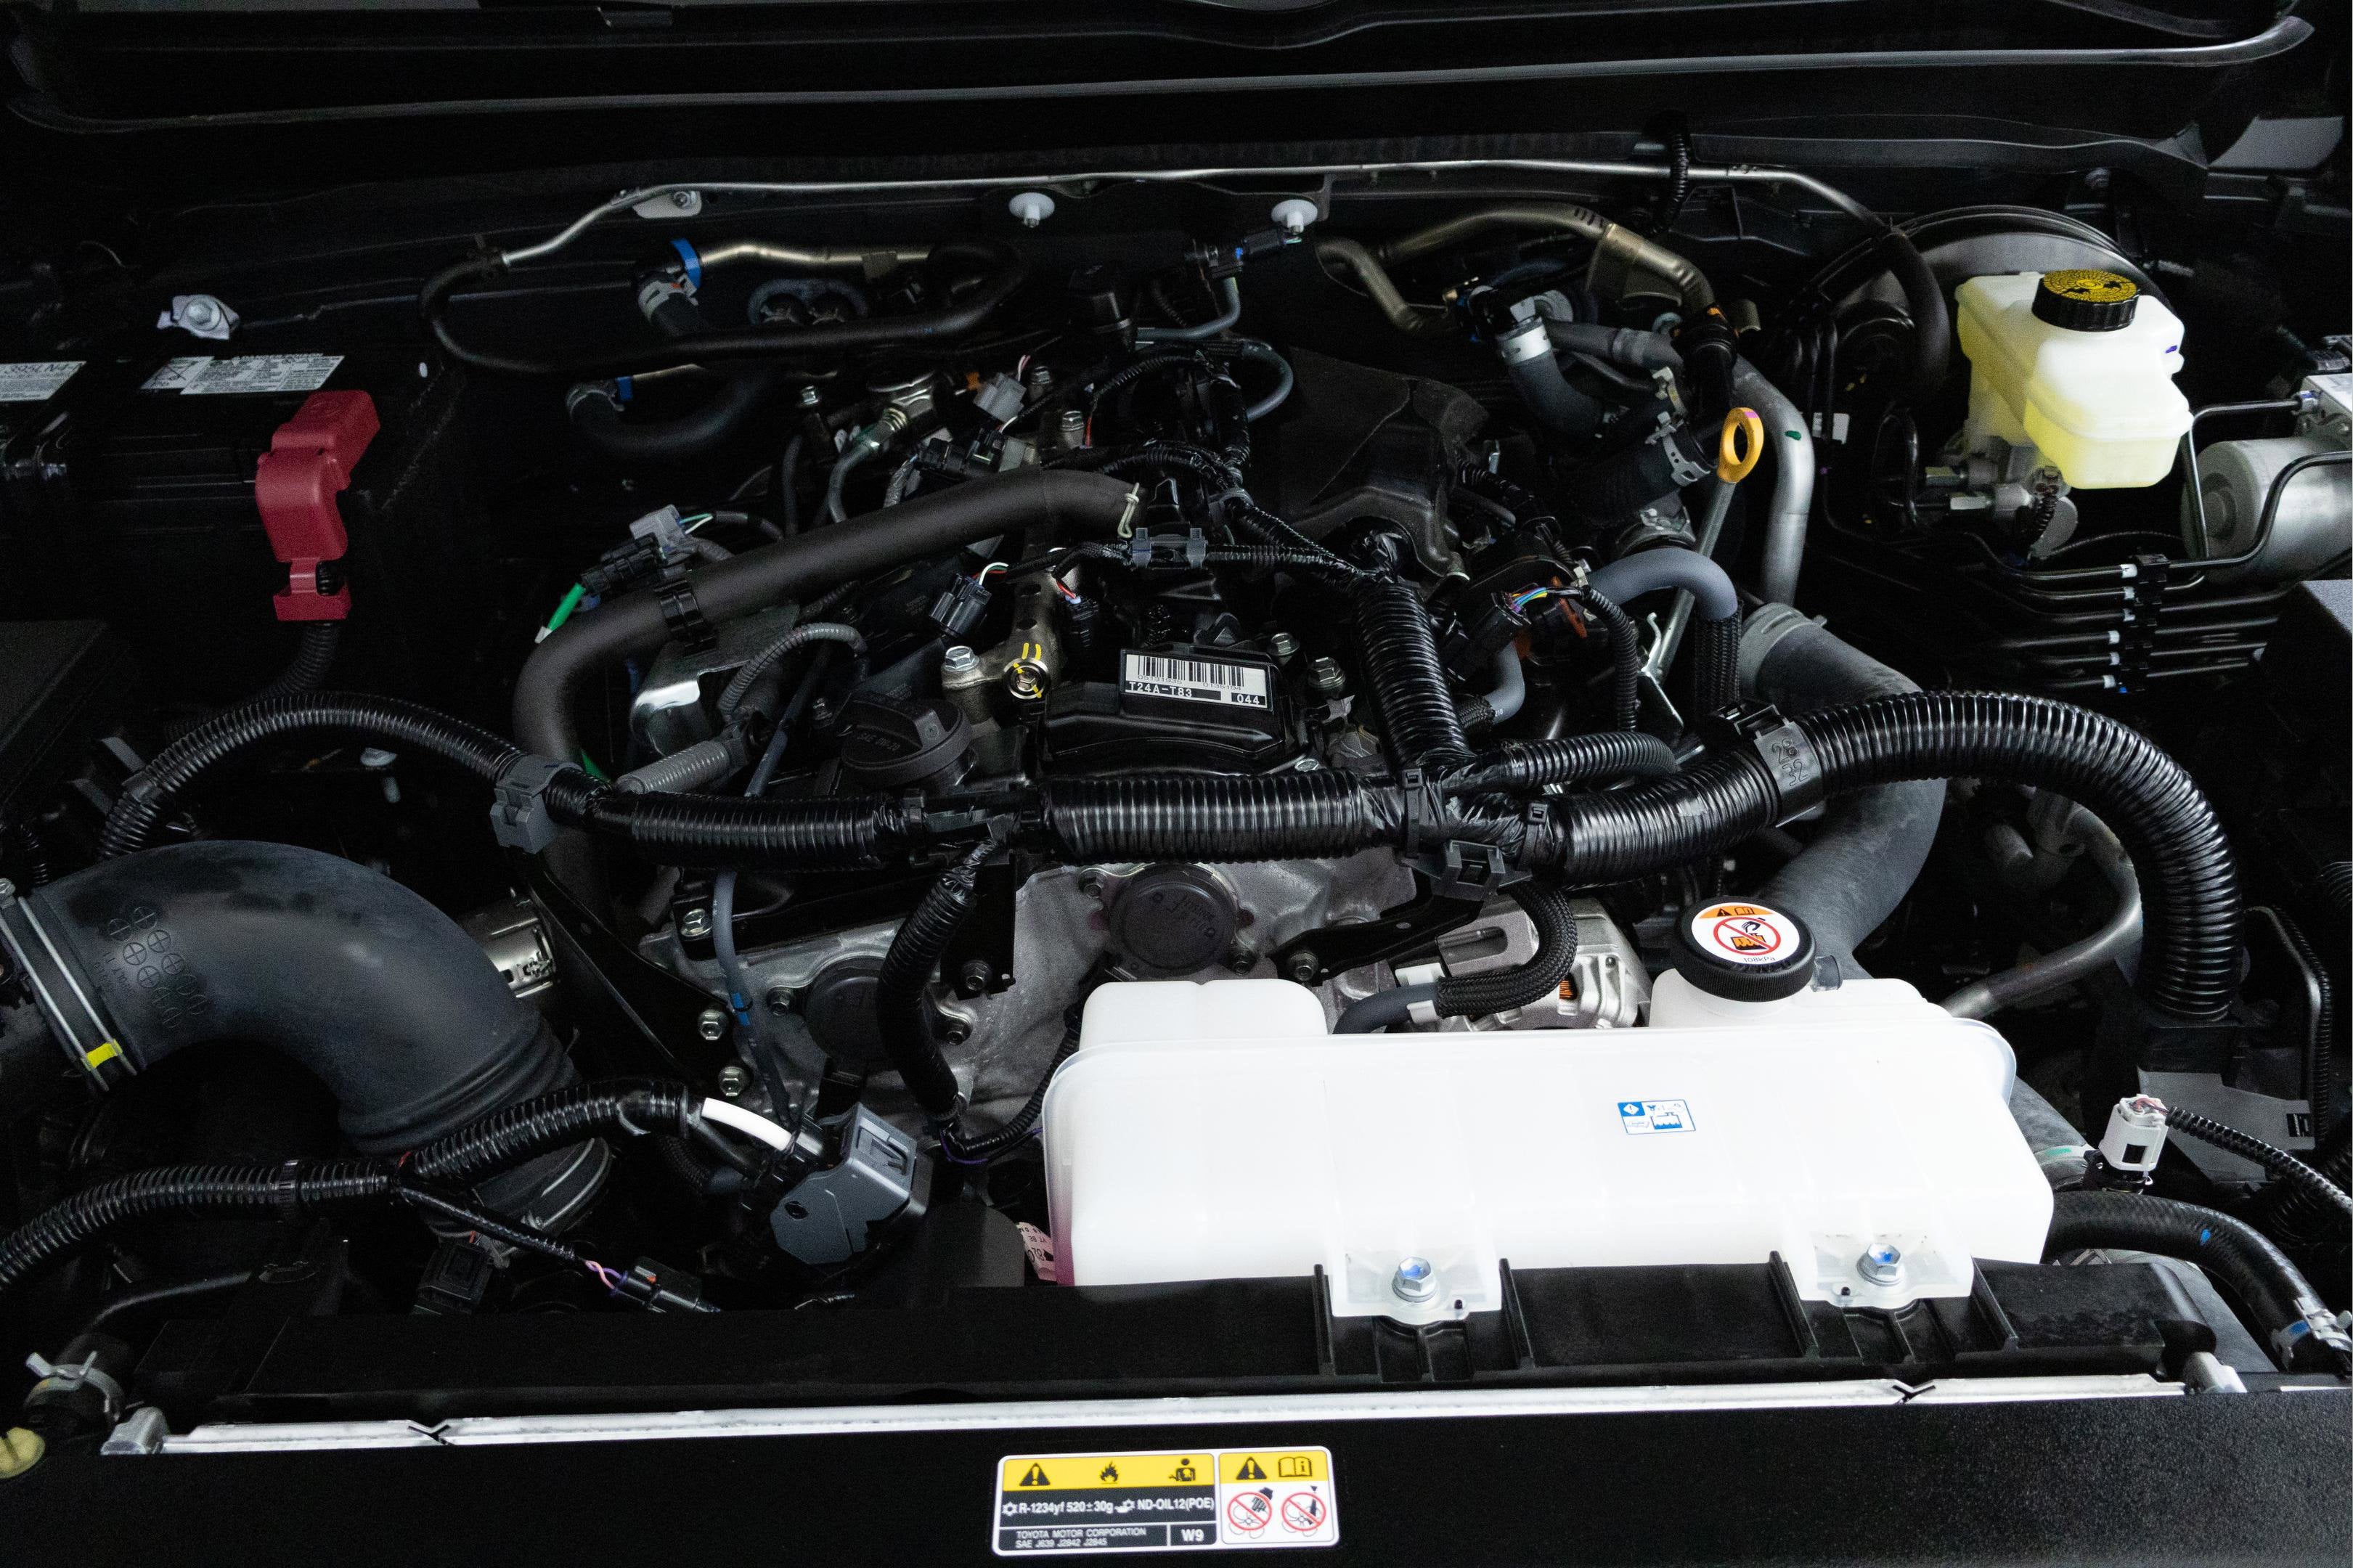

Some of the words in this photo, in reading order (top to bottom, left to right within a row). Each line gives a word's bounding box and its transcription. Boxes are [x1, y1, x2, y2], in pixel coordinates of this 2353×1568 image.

[1129, 682, 1193, 698] T24A-T83
[1237, 694, 1260, 706] 044
[1019, 1502, 1064, 1516] R-1234yf
[1067, 1500, 1114, 1514] 520±30g
[1137, 1498, 1215, 1511] ND-OIL12(POE)
[1016, 1530, 1049, 1540] TOYOTA
[1053, 1529, 1083, 1538] MOTOR
[1086, 1527, 1147, 1538] CORPORATION
[1181, 1529, 1204, 1542] W9
[1016, 1539, 1033, 1548] SAE
